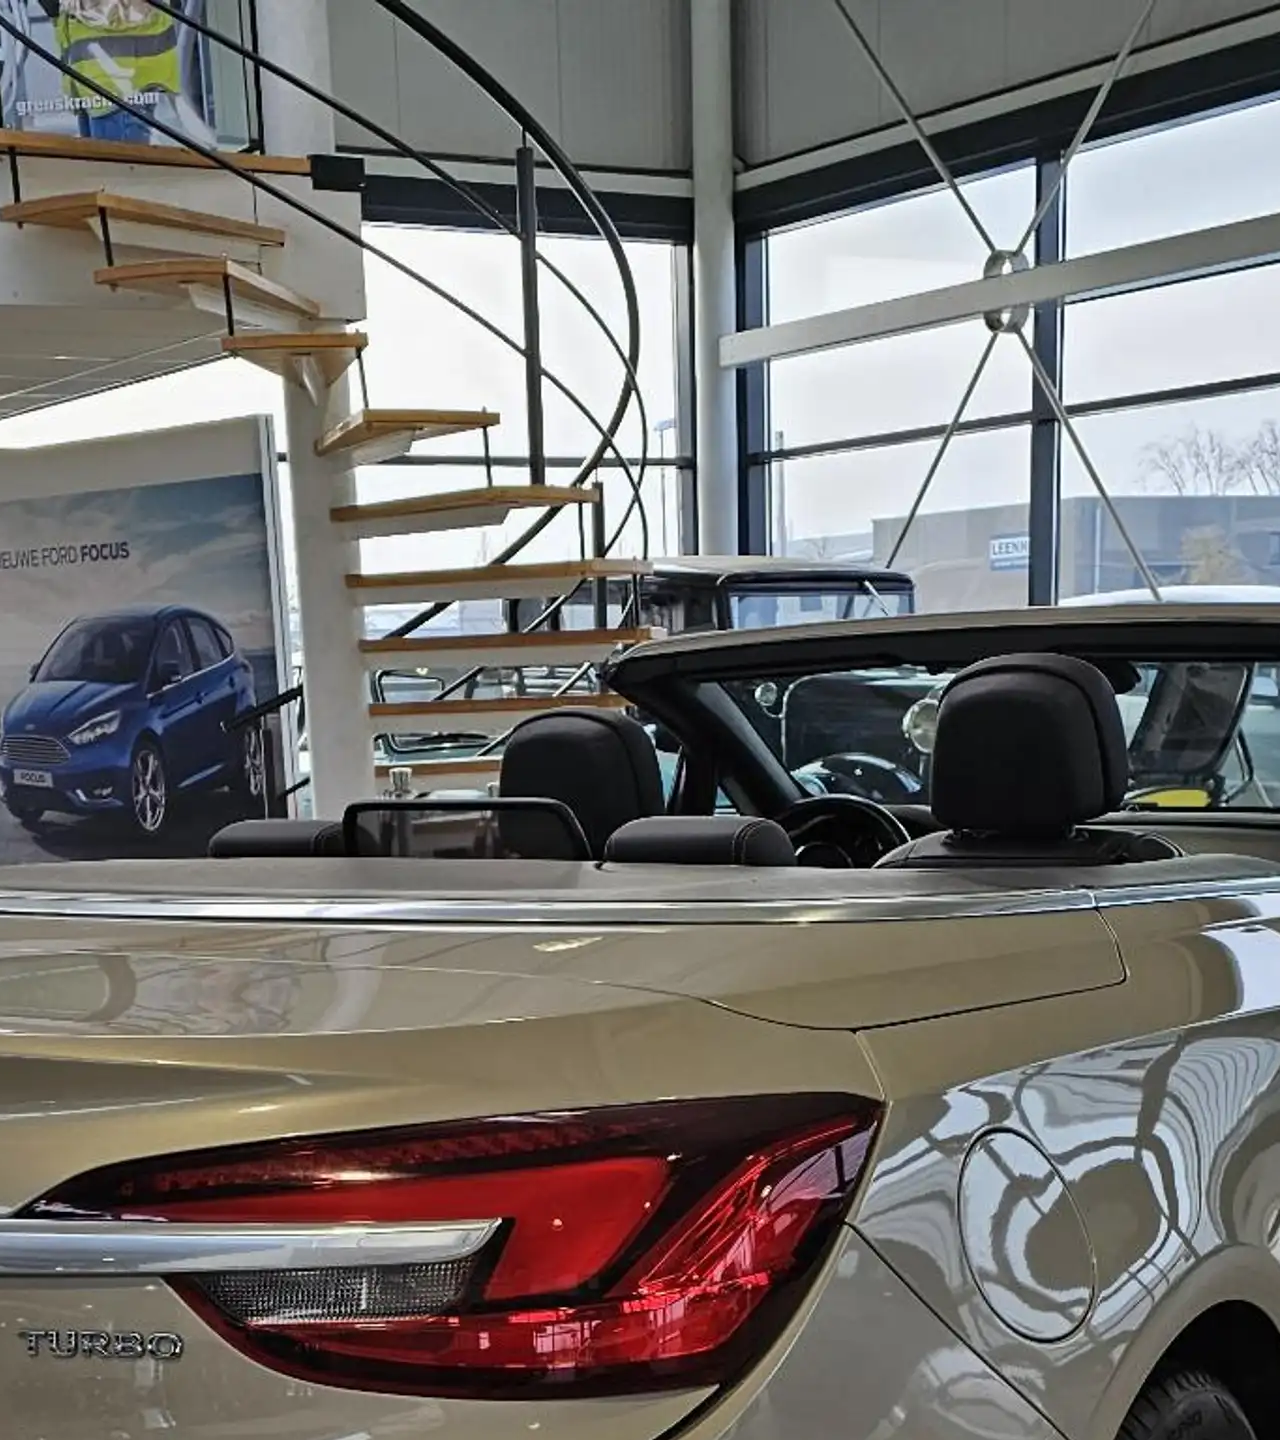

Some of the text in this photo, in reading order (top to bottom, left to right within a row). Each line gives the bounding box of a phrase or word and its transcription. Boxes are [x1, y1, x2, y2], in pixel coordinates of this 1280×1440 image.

[41, 544, 79, 567] FORD
[81, 541, 130, 563] FOCUS
[19, 1329, 184, 1359] TURBO
